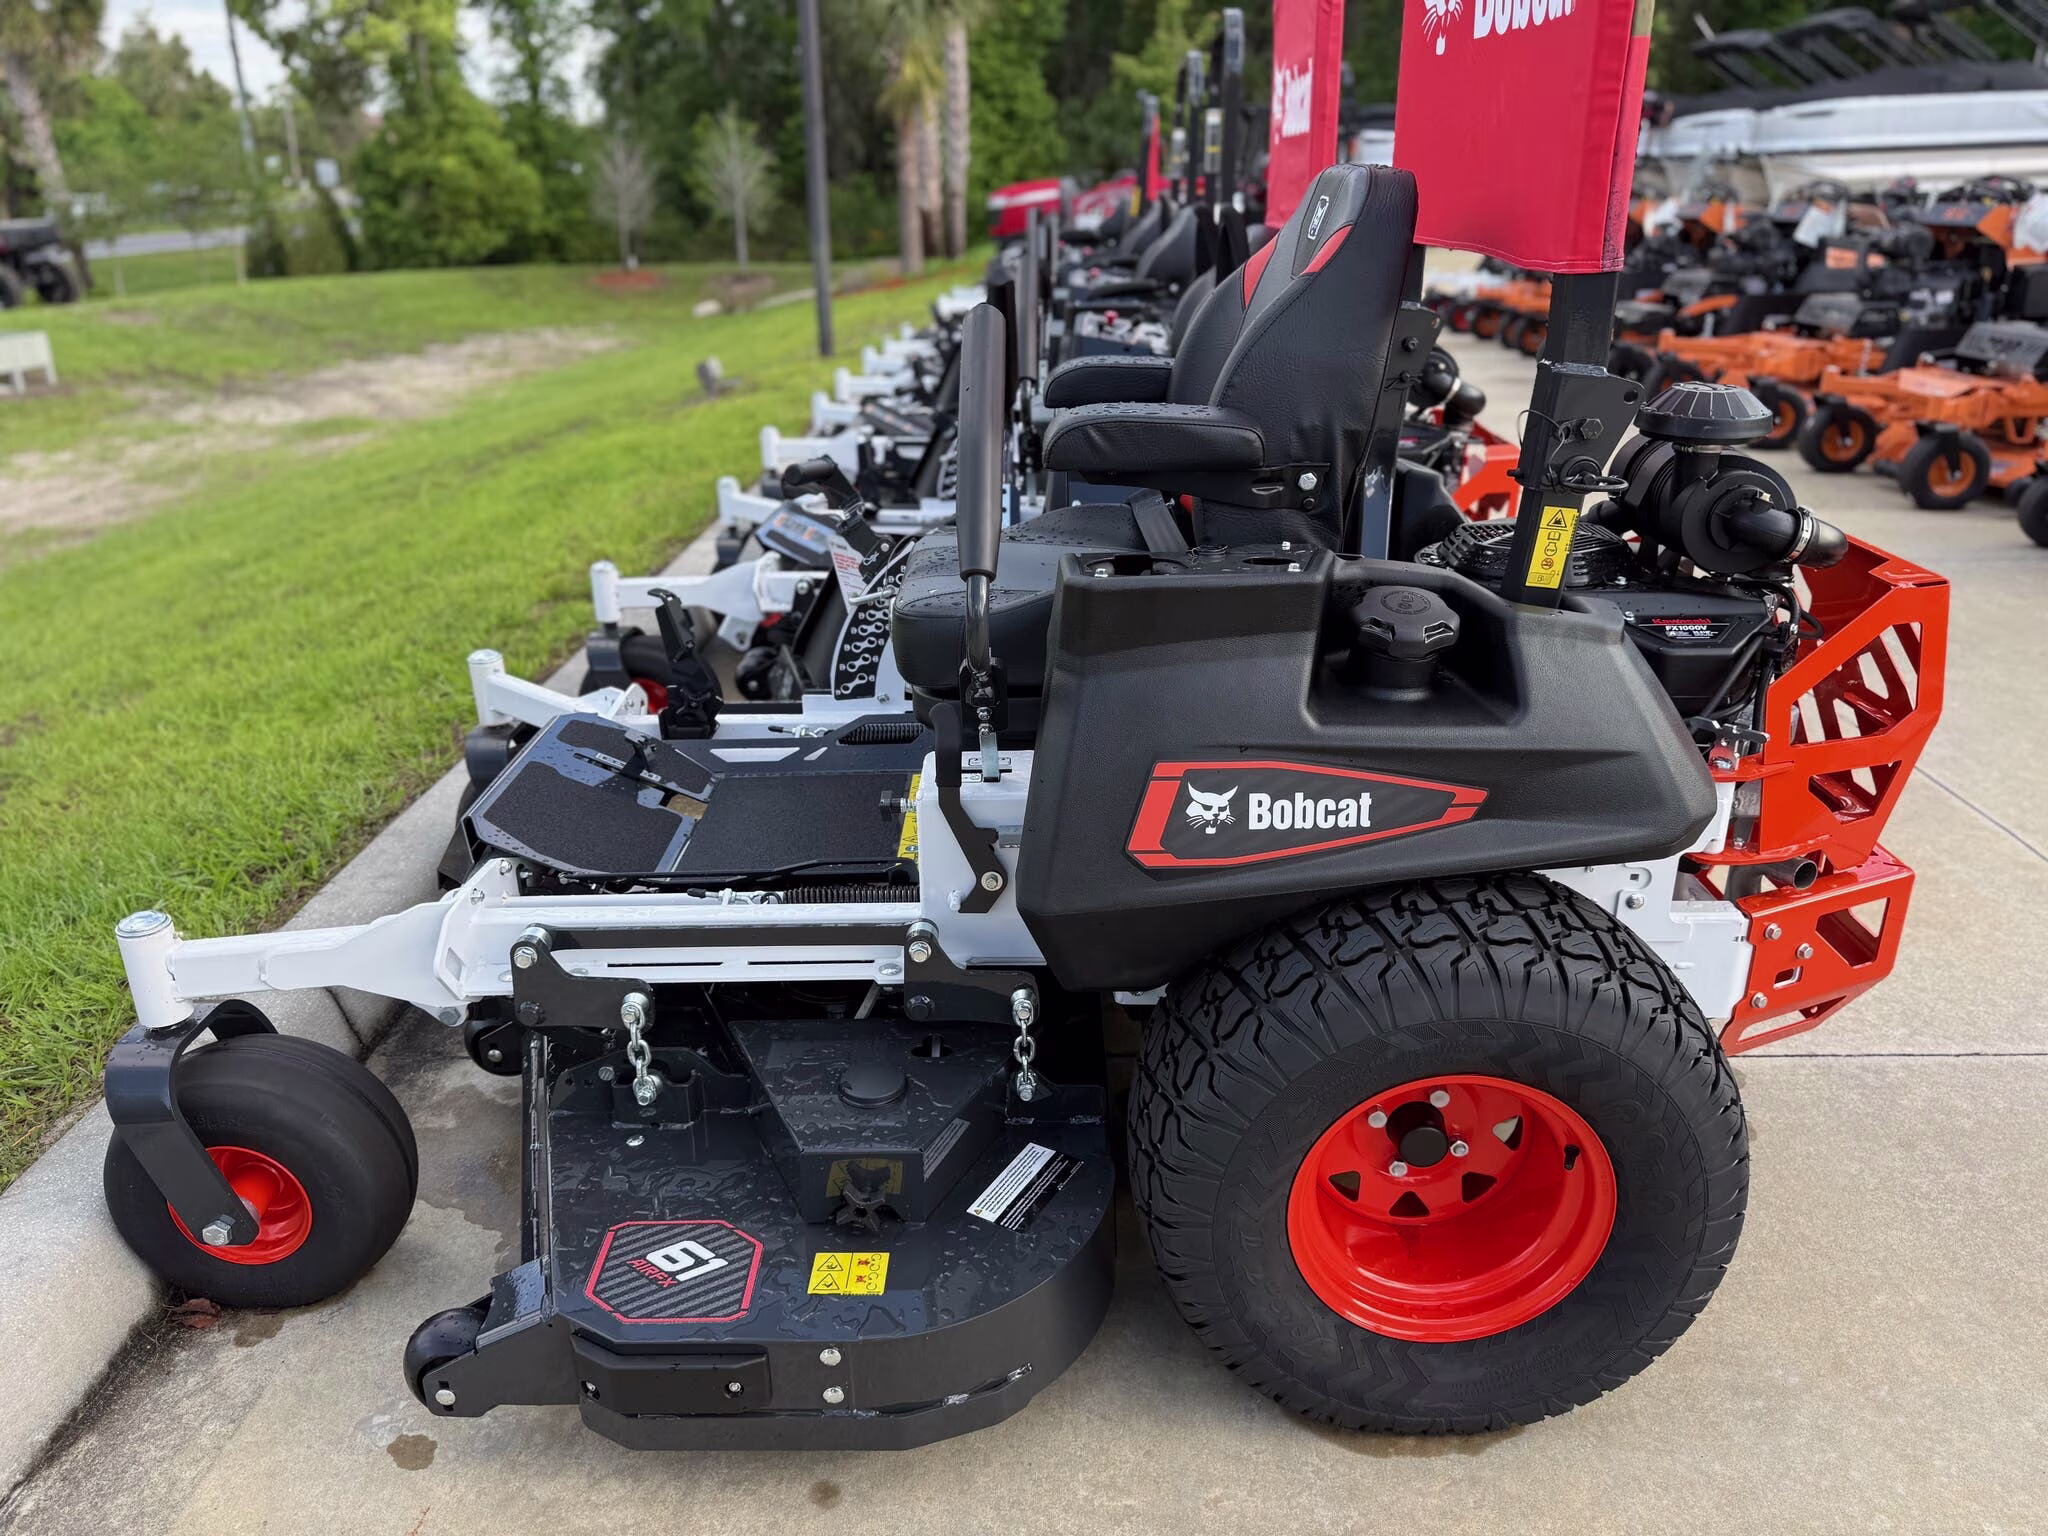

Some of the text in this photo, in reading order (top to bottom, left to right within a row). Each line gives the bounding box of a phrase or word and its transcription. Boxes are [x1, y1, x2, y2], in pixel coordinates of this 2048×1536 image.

[1248, 792, 1372, 830] Bobcat
[626, 1258, 680, 1288] AIRFX
[646, 1240, 729, 1282] 61
